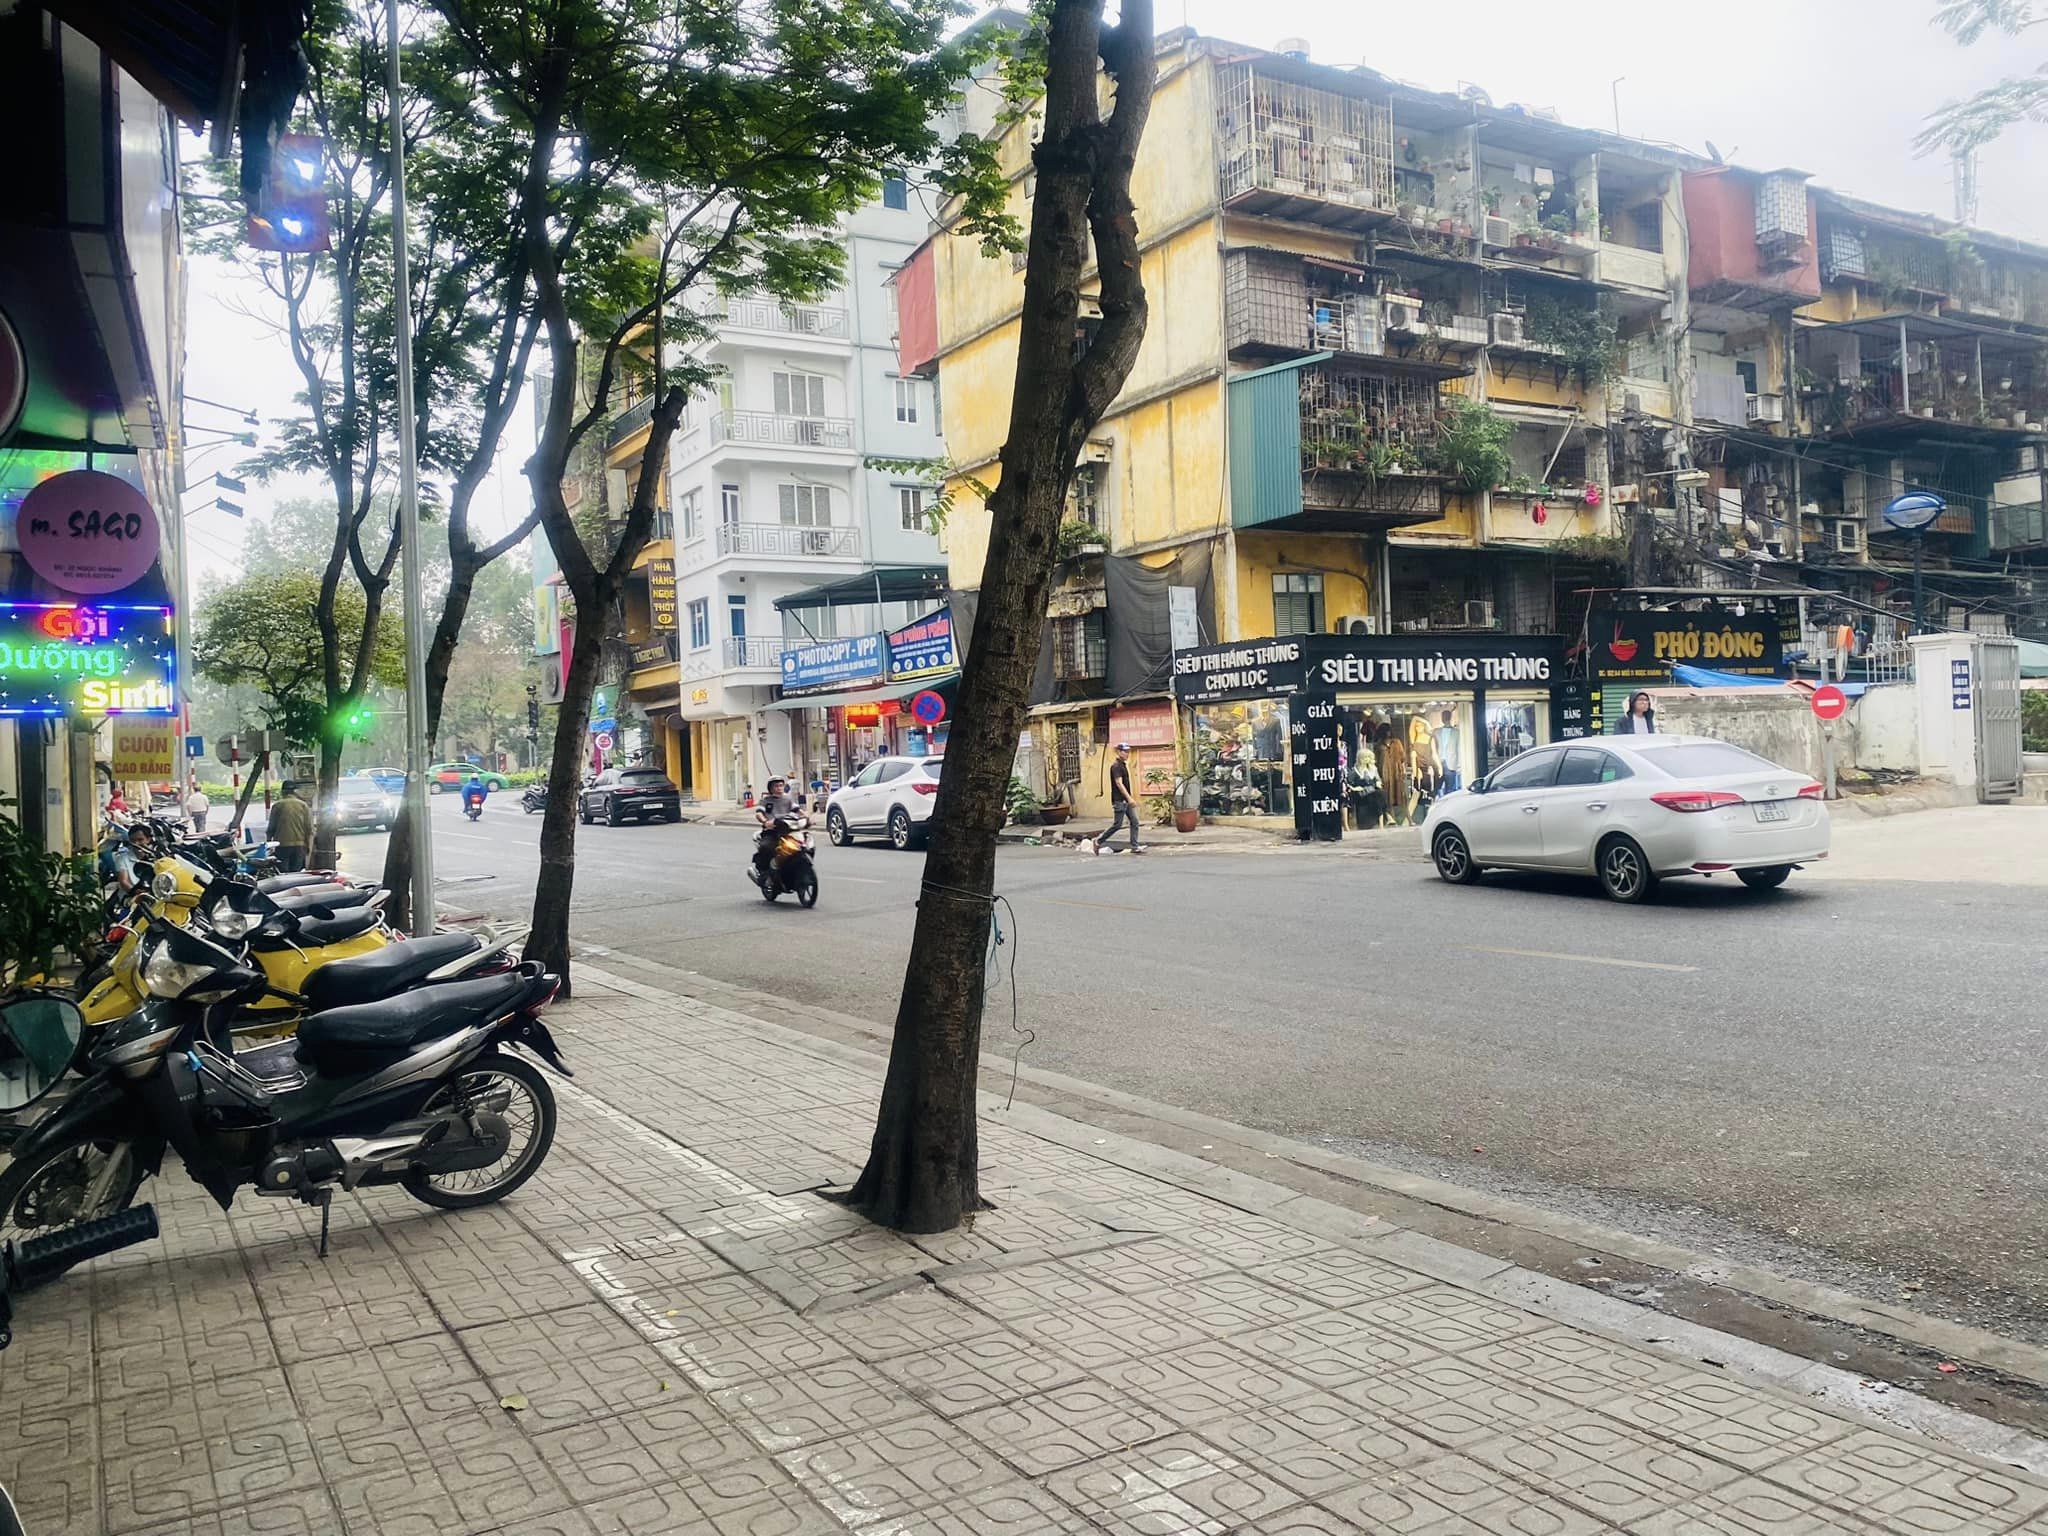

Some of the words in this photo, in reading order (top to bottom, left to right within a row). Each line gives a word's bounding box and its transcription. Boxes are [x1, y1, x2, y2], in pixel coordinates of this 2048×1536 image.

[68, 509, 141, 541] SAGO
[43, 607, 108, 643] Gội
[1653, 622, 1699, 658] PHỞ
[1703, 625, 1764, 658] ĐÔNG
[798, 641, 851, 668] PHOTOCOPY
[857, 636, 877, 657] VPP
[1176, 654, 1202, 675] SIÊU
[1201, 653, 1220, 673] THỊ
[1255, 641, 1299, 665] THÙNG
[1205, 670, 1240, 691] CHỌN
[1241, 669, 1268, 689] LỌC
[1322, 653, 1374, 683] SIÊU
[1377, 658, 1415, 686] THỊ
[1418, 652, 1478, 682] HÀNG
[1480, 652, 1549, 681] THÙNG
[83, 680, 167, 708] Sinh
[1313, 767, 1335, 783] PHỤ
[1312, 796, 1339, 815] KIỆN
